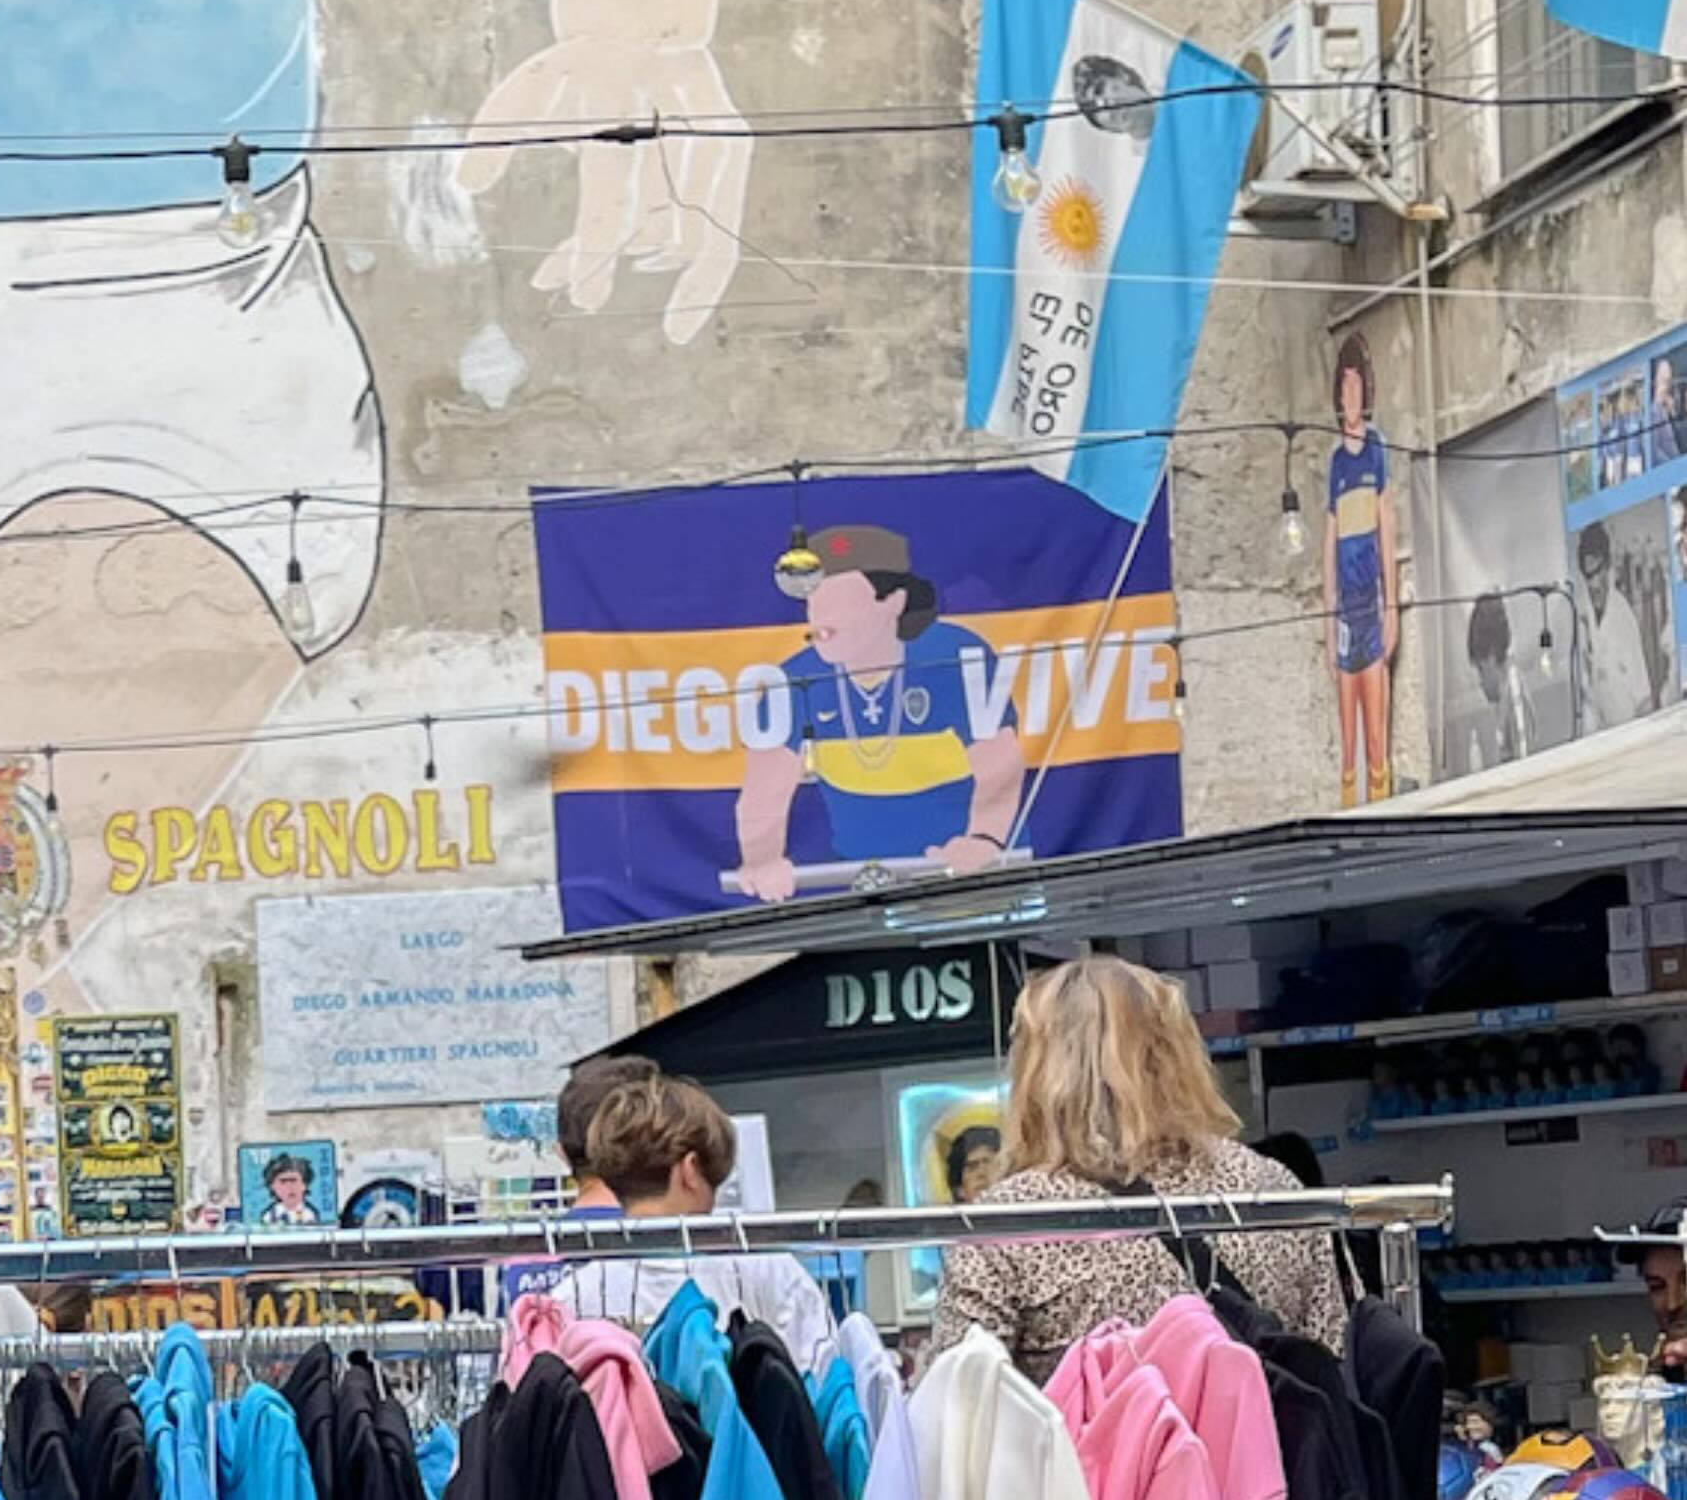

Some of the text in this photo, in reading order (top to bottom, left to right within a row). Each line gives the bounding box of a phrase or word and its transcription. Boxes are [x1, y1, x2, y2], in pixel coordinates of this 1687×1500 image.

[548, 628, 1173, 752] DIEGO VIVE
[104, 784, 496, 895] SPAGNOLI
[400, 930, 463, 949] LARGO
[293, 980, 574, 1012] DIEGO ARMANDO MARADONA
[333, 1041, 539, 1067] QUARTIERI SPAGNOLI
